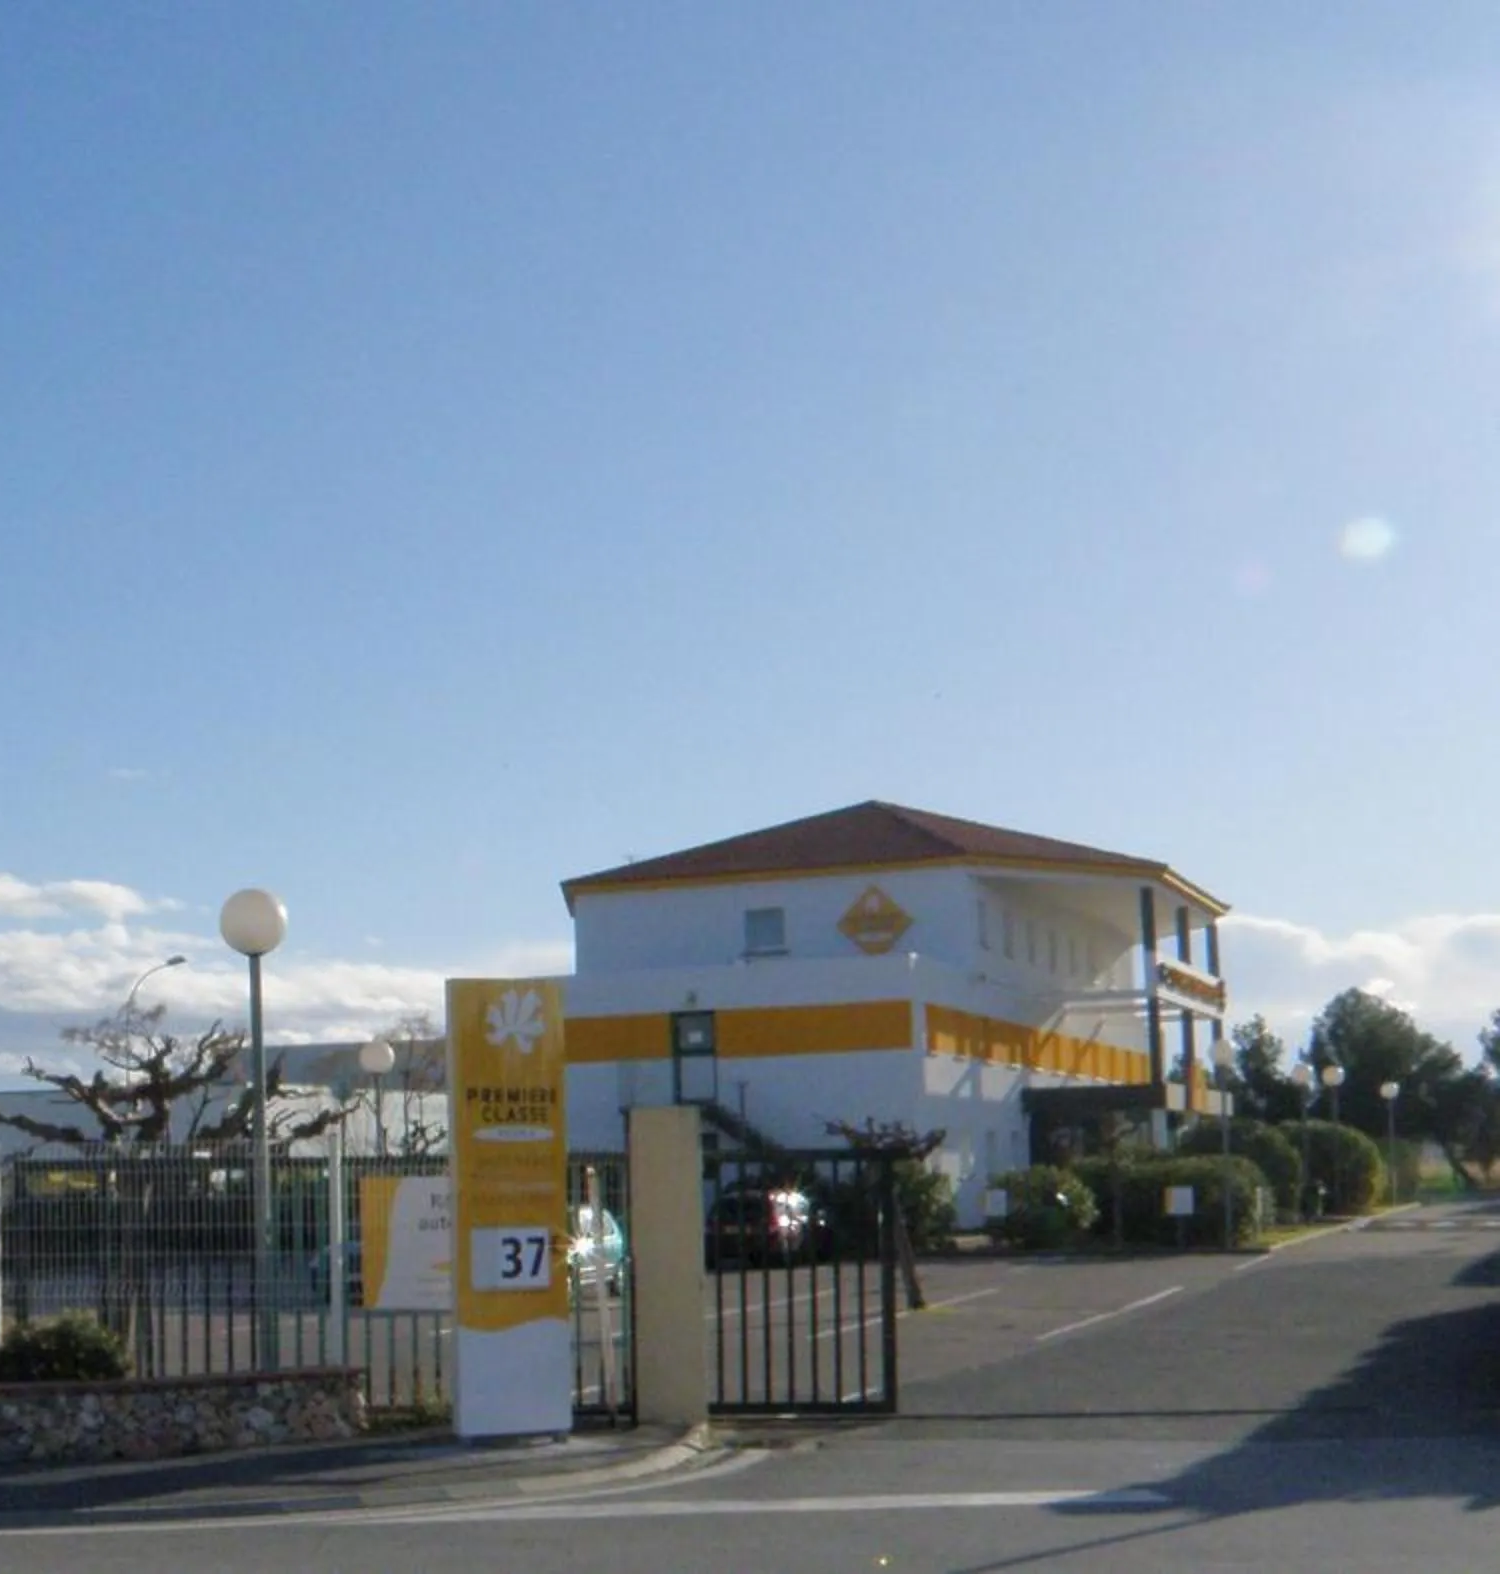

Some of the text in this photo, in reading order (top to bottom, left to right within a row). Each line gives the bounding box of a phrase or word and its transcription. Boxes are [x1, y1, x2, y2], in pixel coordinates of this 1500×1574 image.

[466, 1087, 557, 1104] PREMIERE
[481, 1104, 548, 1122] CLASSE
[501, 1236, 545, 1279] 37
